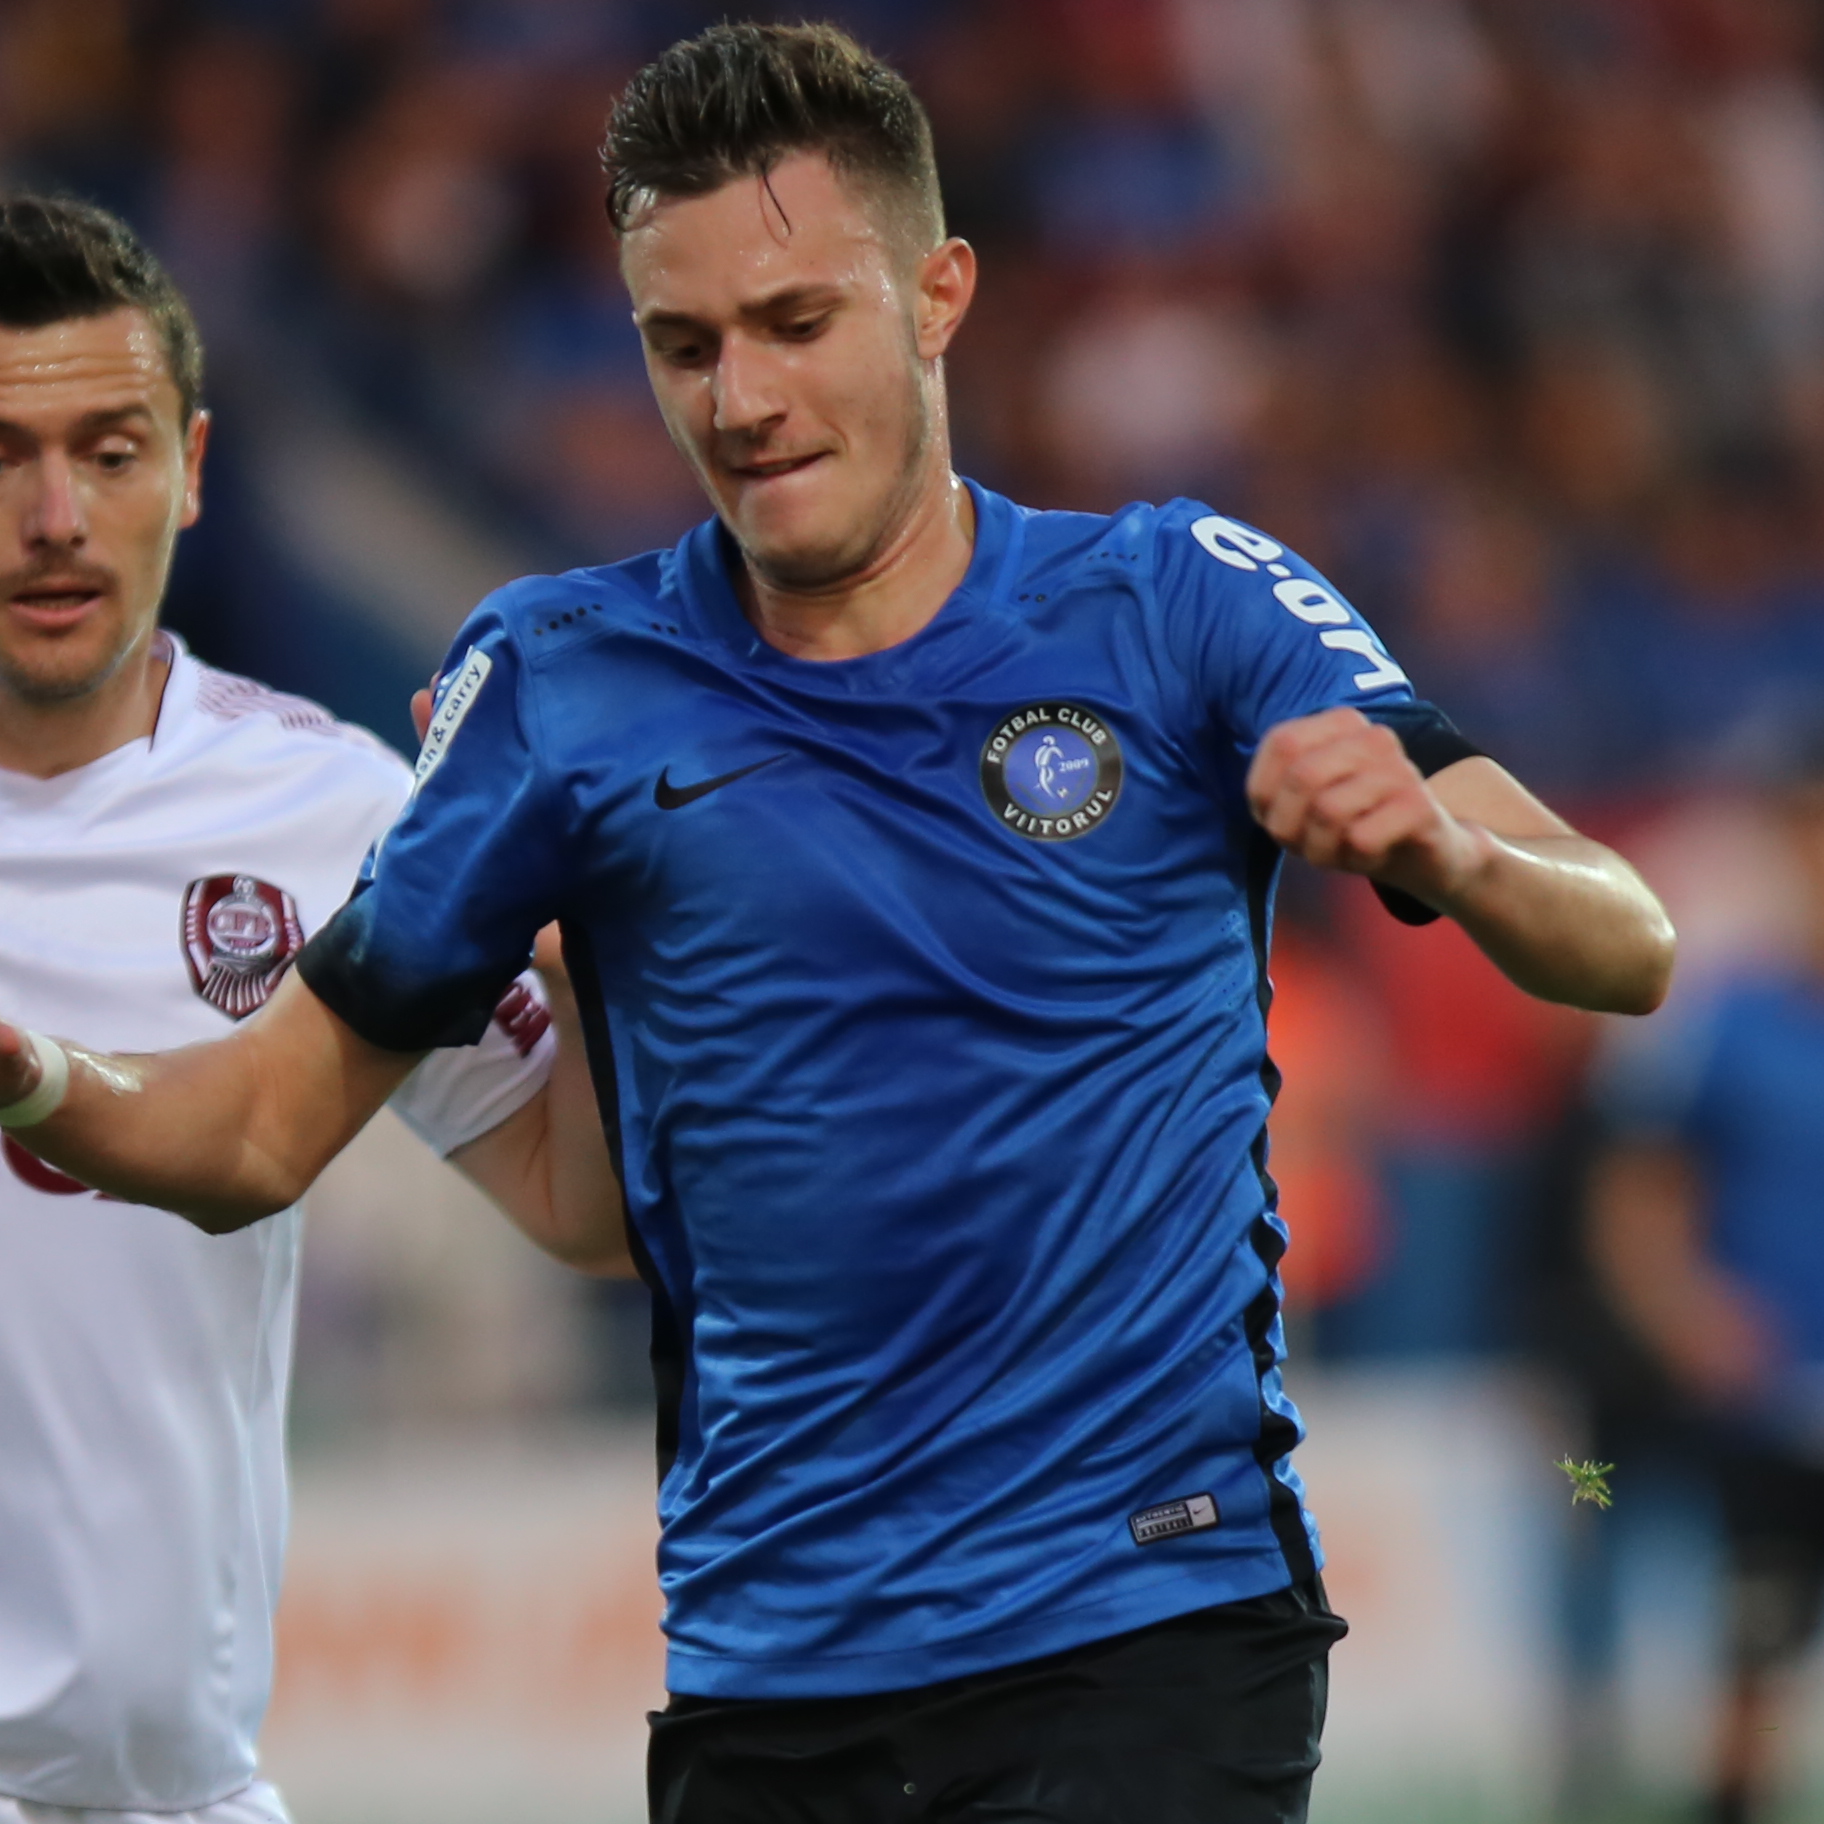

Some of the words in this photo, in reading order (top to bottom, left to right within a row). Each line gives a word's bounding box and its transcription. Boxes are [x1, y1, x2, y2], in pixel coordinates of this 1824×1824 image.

[432, 726, 447, 743] &
[443, 664, 482, 722] carry
[987, 707, 1051, 764] FOTBAL
[1057, 707, 1107, 746] CLUB
[1058, 757, 1090, 773] 2009
[1003, 789, 1114, 835] VIITORUL
